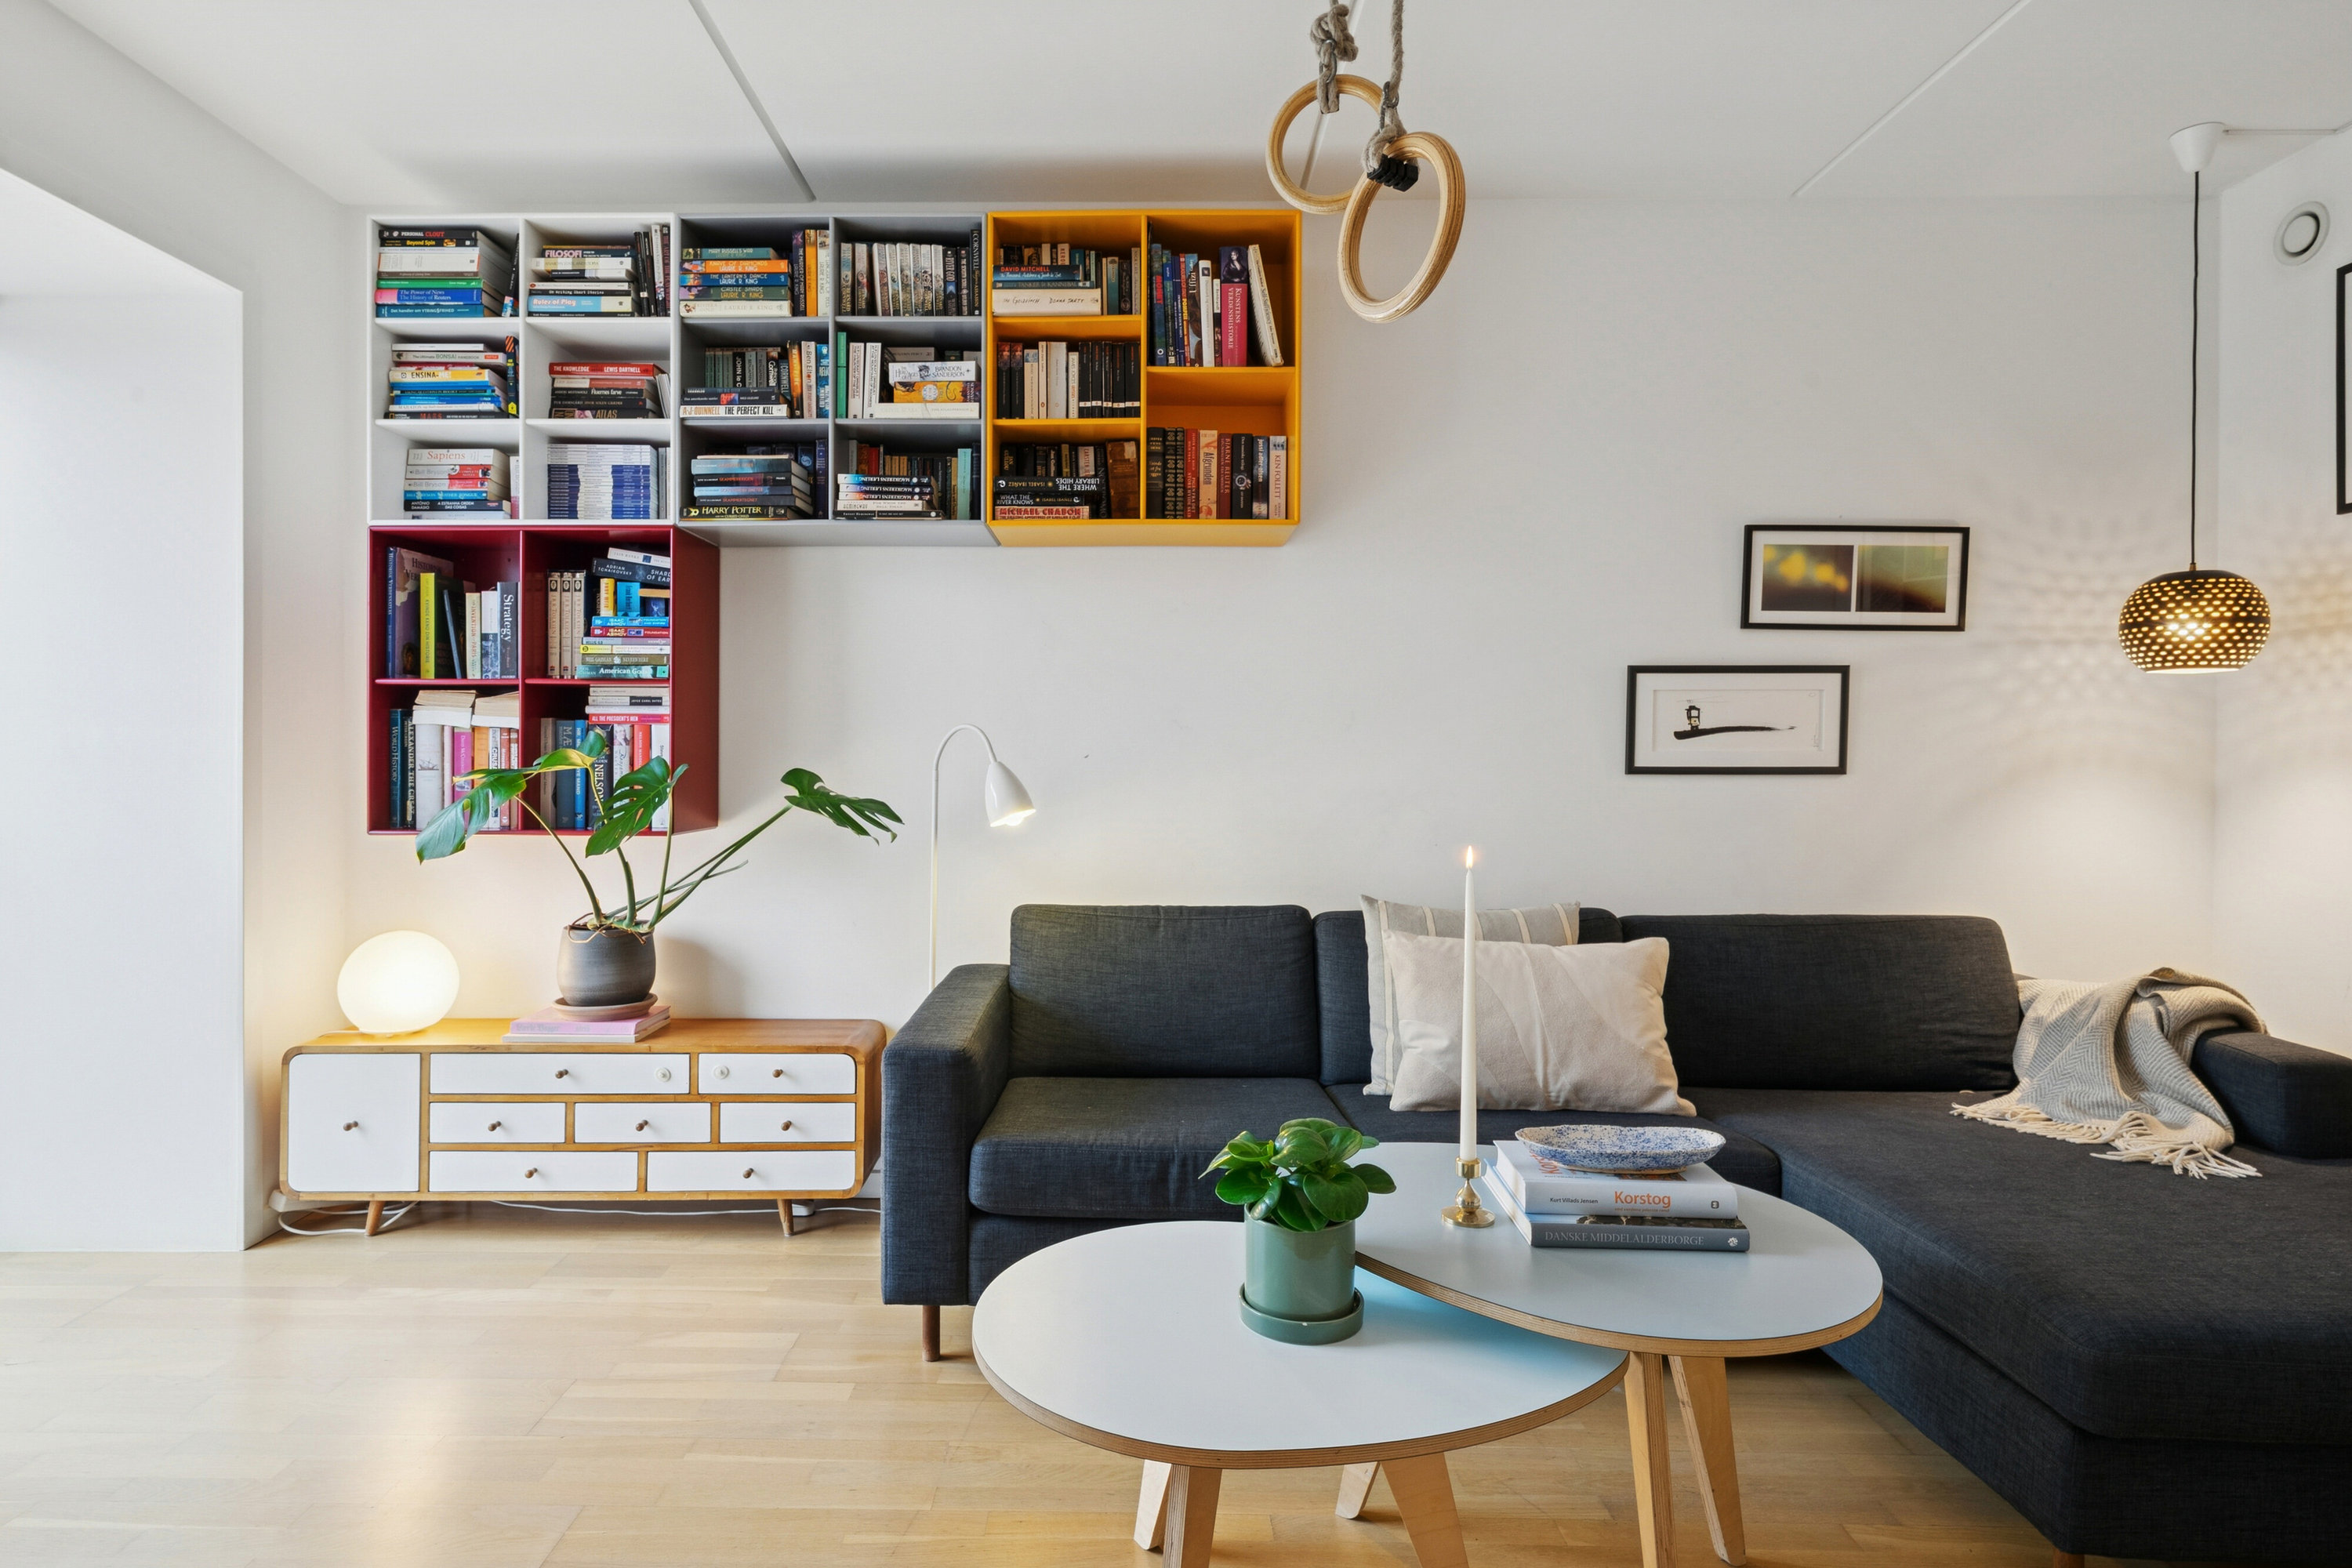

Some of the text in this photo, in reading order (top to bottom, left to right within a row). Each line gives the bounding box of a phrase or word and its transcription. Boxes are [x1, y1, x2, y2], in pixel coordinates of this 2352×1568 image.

[946, 257, 955, 281] RIVER GOD
[780, 365, 789, 394] CORNWELL
[596, 410, 617, 419] ATLAS
[725, 406, 734, 415] THE
[737, 406, 760, 415] PERFECT
[763, 406, 774, 414] KILL
[427, 451, 466, 463] Sapiens
[1203, 452, 1214, 485] Afgrunden
[702, 506, 762, 515] HARRY POTTER
[598, 567, 632, 575] TCHAIKOVSKY
[501, 594, 515, 642] Strategy
[594, 764, 604, 802] NELSON
[1615, 1191, 1671, 1208] Korstog
[1545, 1232, 1704, 1245] DANSKE MIDDELALDERBORGE
